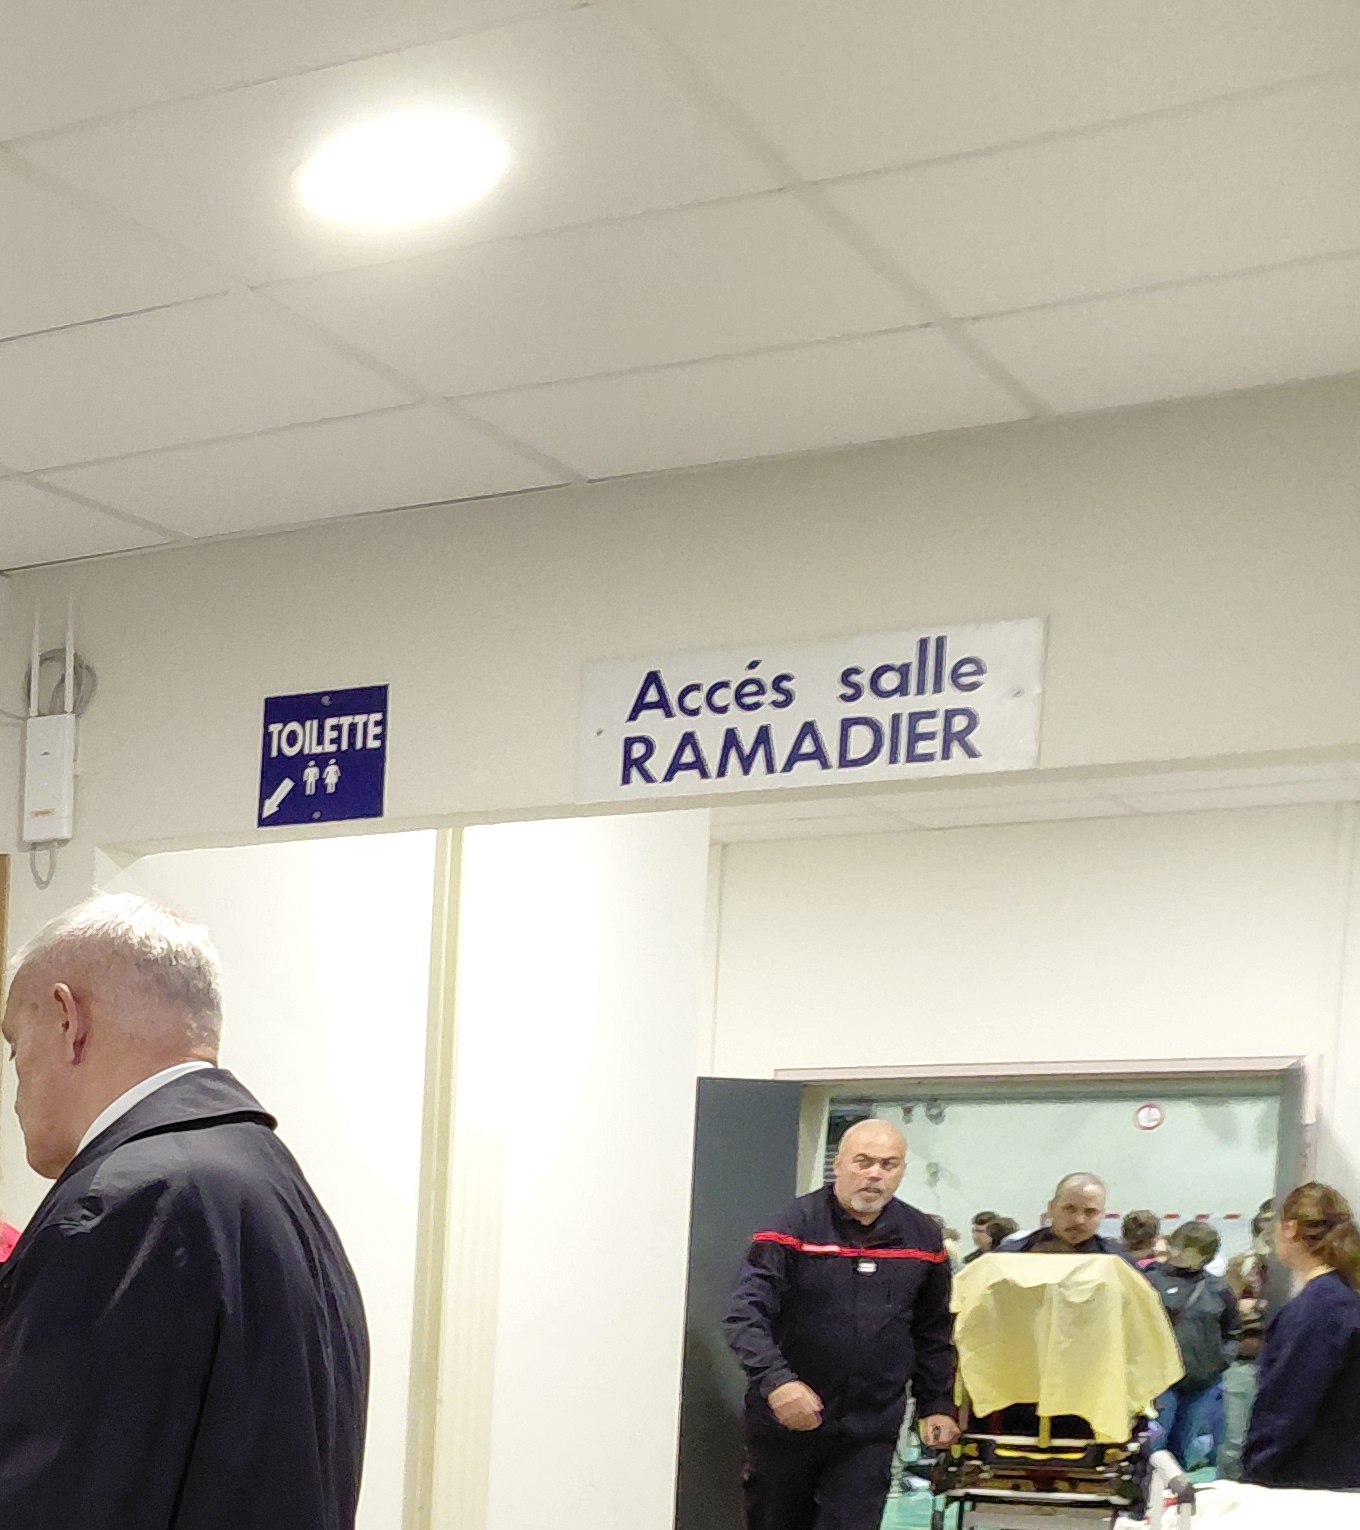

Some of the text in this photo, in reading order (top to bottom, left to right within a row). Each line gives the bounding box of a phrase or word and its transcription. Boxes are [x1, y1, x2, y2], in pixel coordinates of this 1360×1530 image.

[625, 635, 988, 724] Accés salle
[268, 712, 383, 759] TOILETTE
[620, 707, 983, 787] RAMADIER
